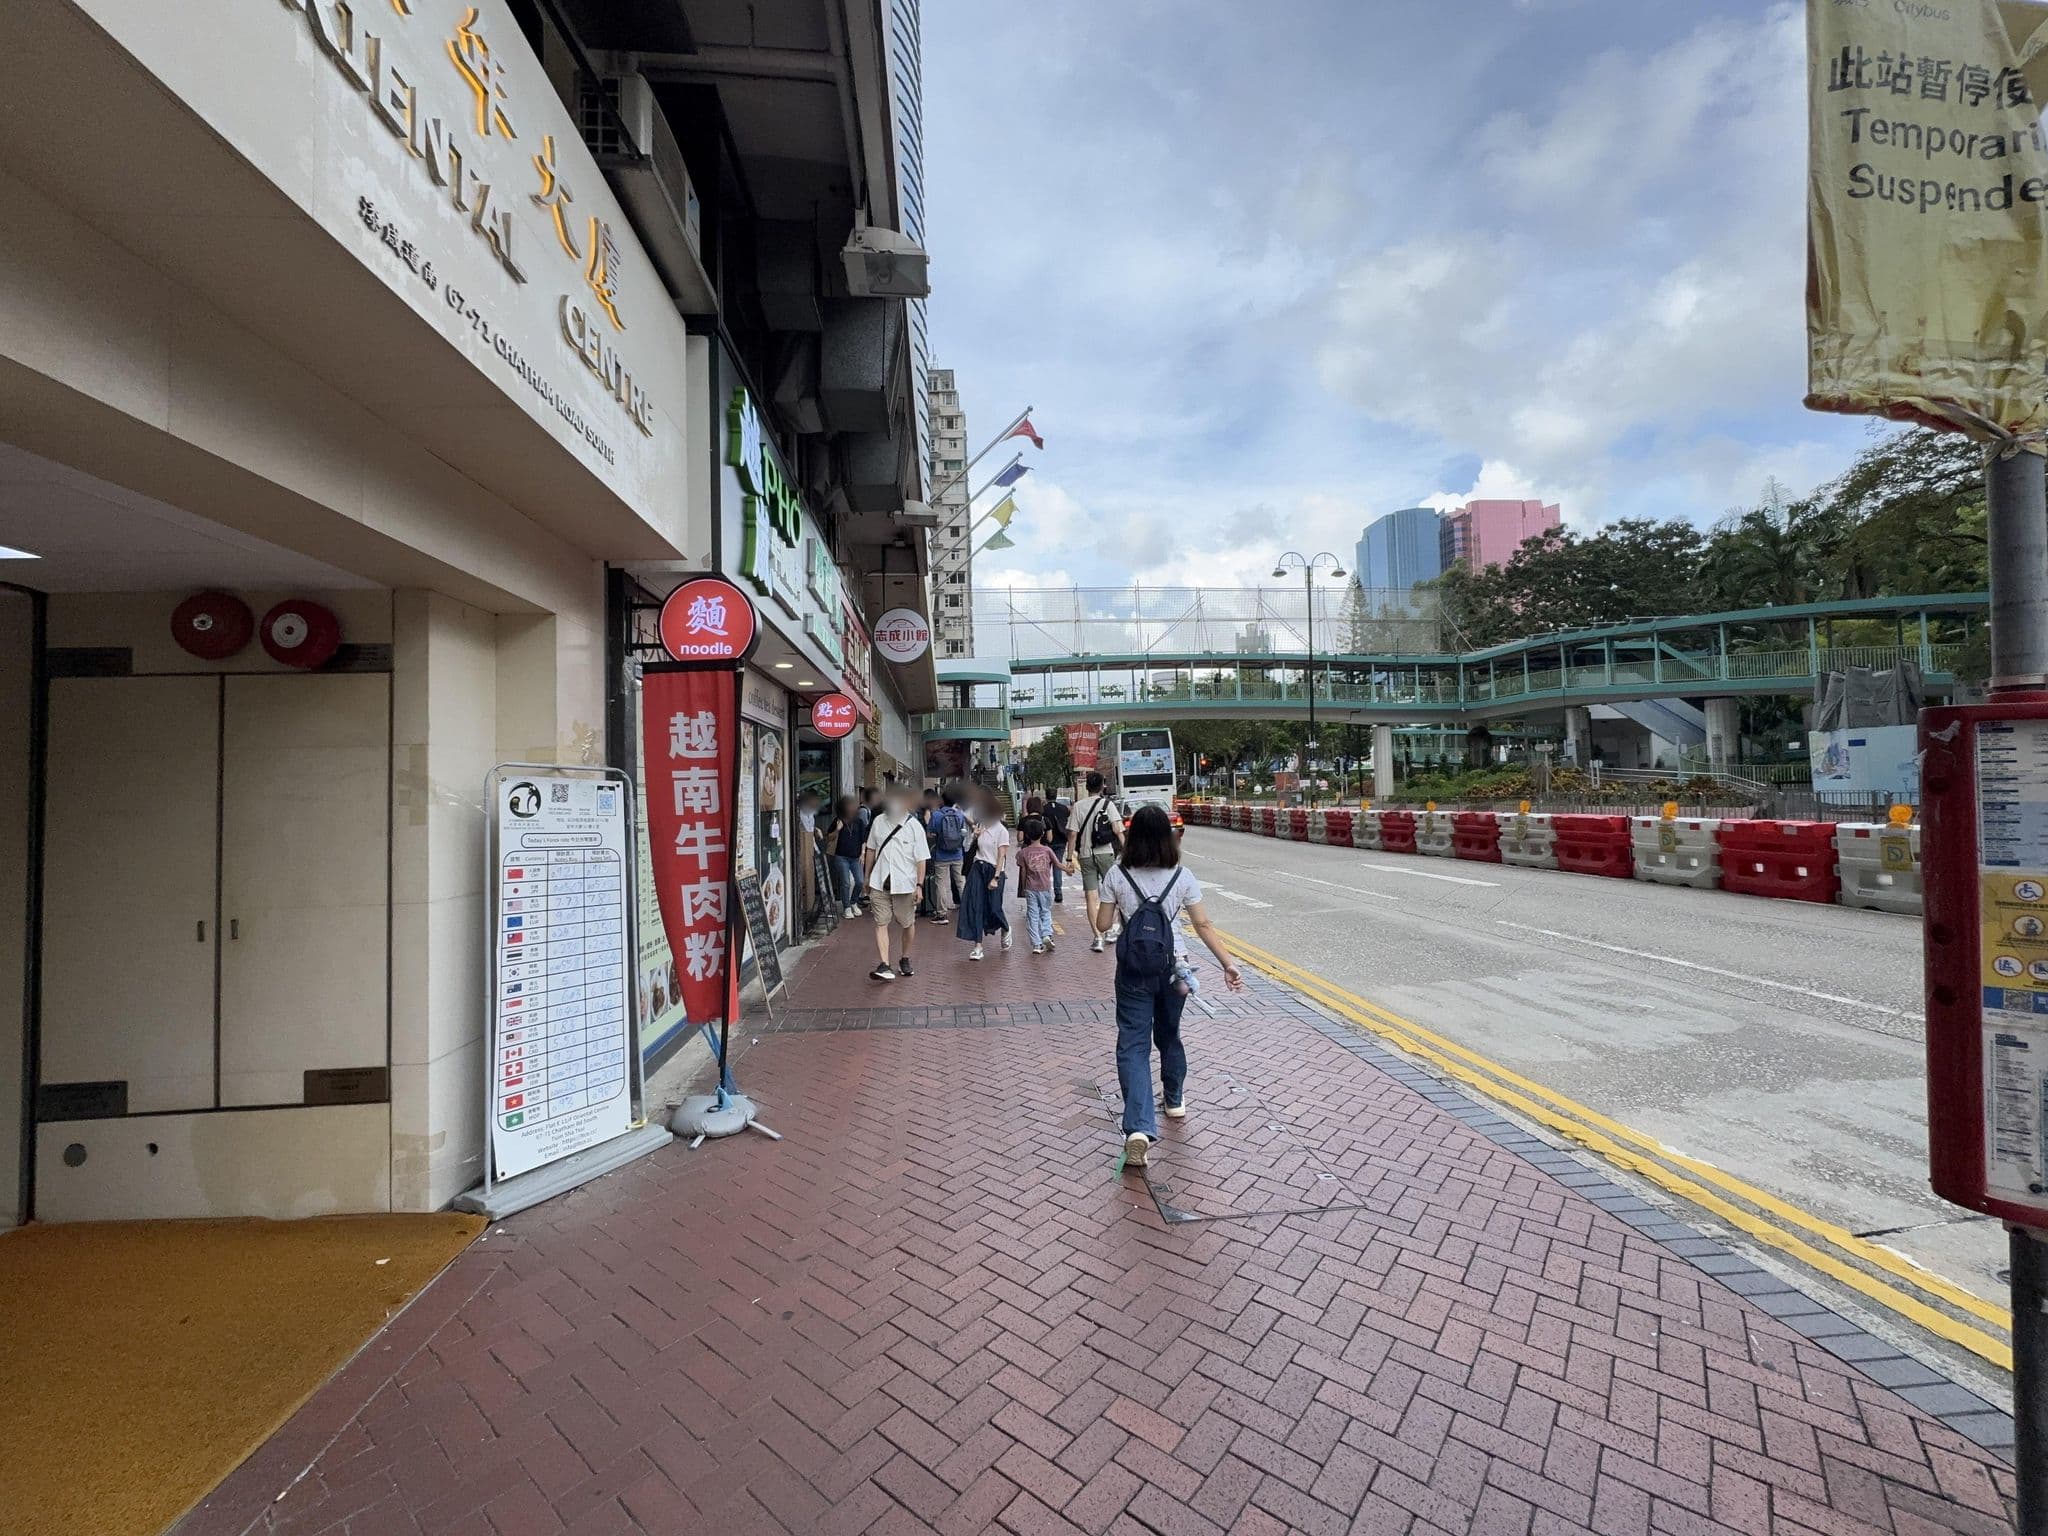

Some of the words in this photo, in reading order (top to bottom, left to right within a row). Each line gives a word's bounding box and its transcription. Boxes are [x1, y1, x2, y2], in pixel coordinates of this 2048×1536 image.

[1894, 0, 1951, 21] Citybus
[1841, 107, 2048, 160] Temporari
[388, 0, 626, 331] 年大廈
[1847, 163, 2048, 214] Suspende
[285, 0, 528, 284] RIENTAL
[558, 294, 653, 438] CENTRE
[445, 284, 492, 343] 67-71
[493, 333, 554, 406] CHATHAM
[555, 393, 584, 434] ROAD
[585, 425, 615, 465] SOUTH
[685, 595, 729, 636] 麵
[680, 642, 733, 655] noodle
[817, 701, 852, 717] 點心
[668, 710, 728, 982] 越南牛肉粉
